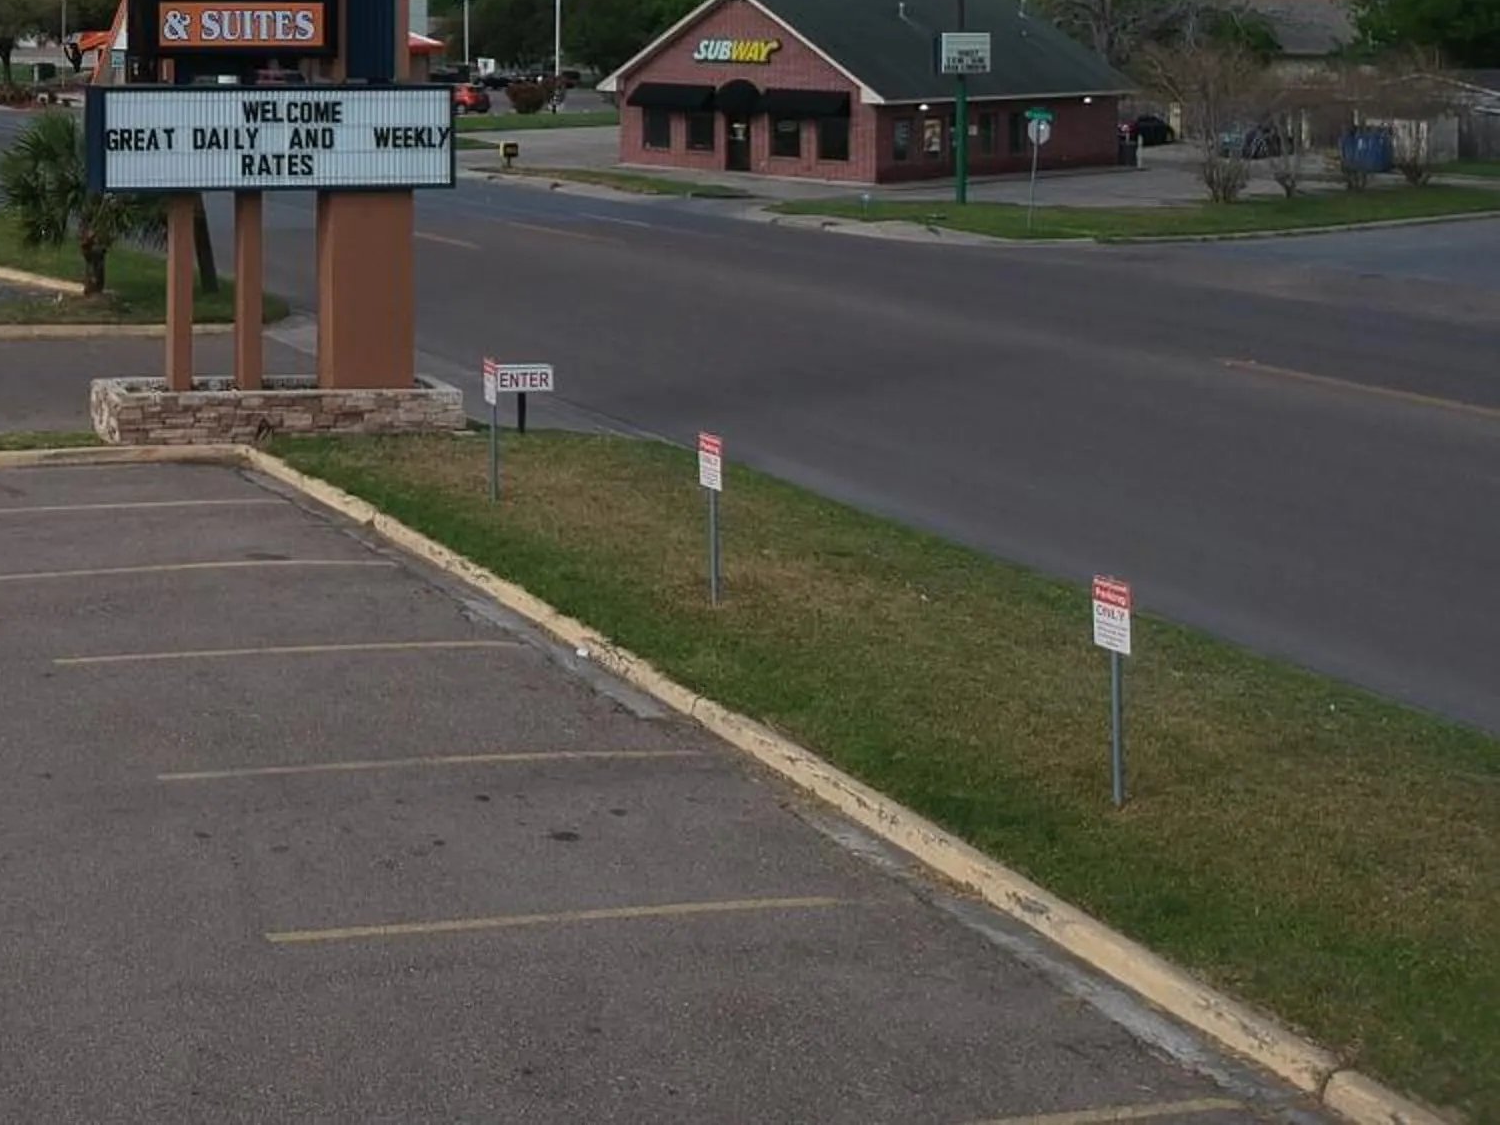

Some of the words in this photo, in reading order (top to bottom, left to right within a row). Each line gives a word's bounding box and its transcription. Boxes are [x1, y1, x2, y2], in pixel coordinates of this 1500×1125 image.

[163, 10, 190, 41] &
[200, 10, 315, 41] SUITES
[693, 39, 780, 62] SUBWAY
[242, 101, 343, 124] WELCOME
[106, 128, 175, 152] GREAT
[193, 128, 259, 150] DAILY
[289, 127, 335, 150] AND
[373, 126, 451, 149] WEEKLY
[241, 154, 314, 176] RATES
[500, 372, 549, 388] ENTER
